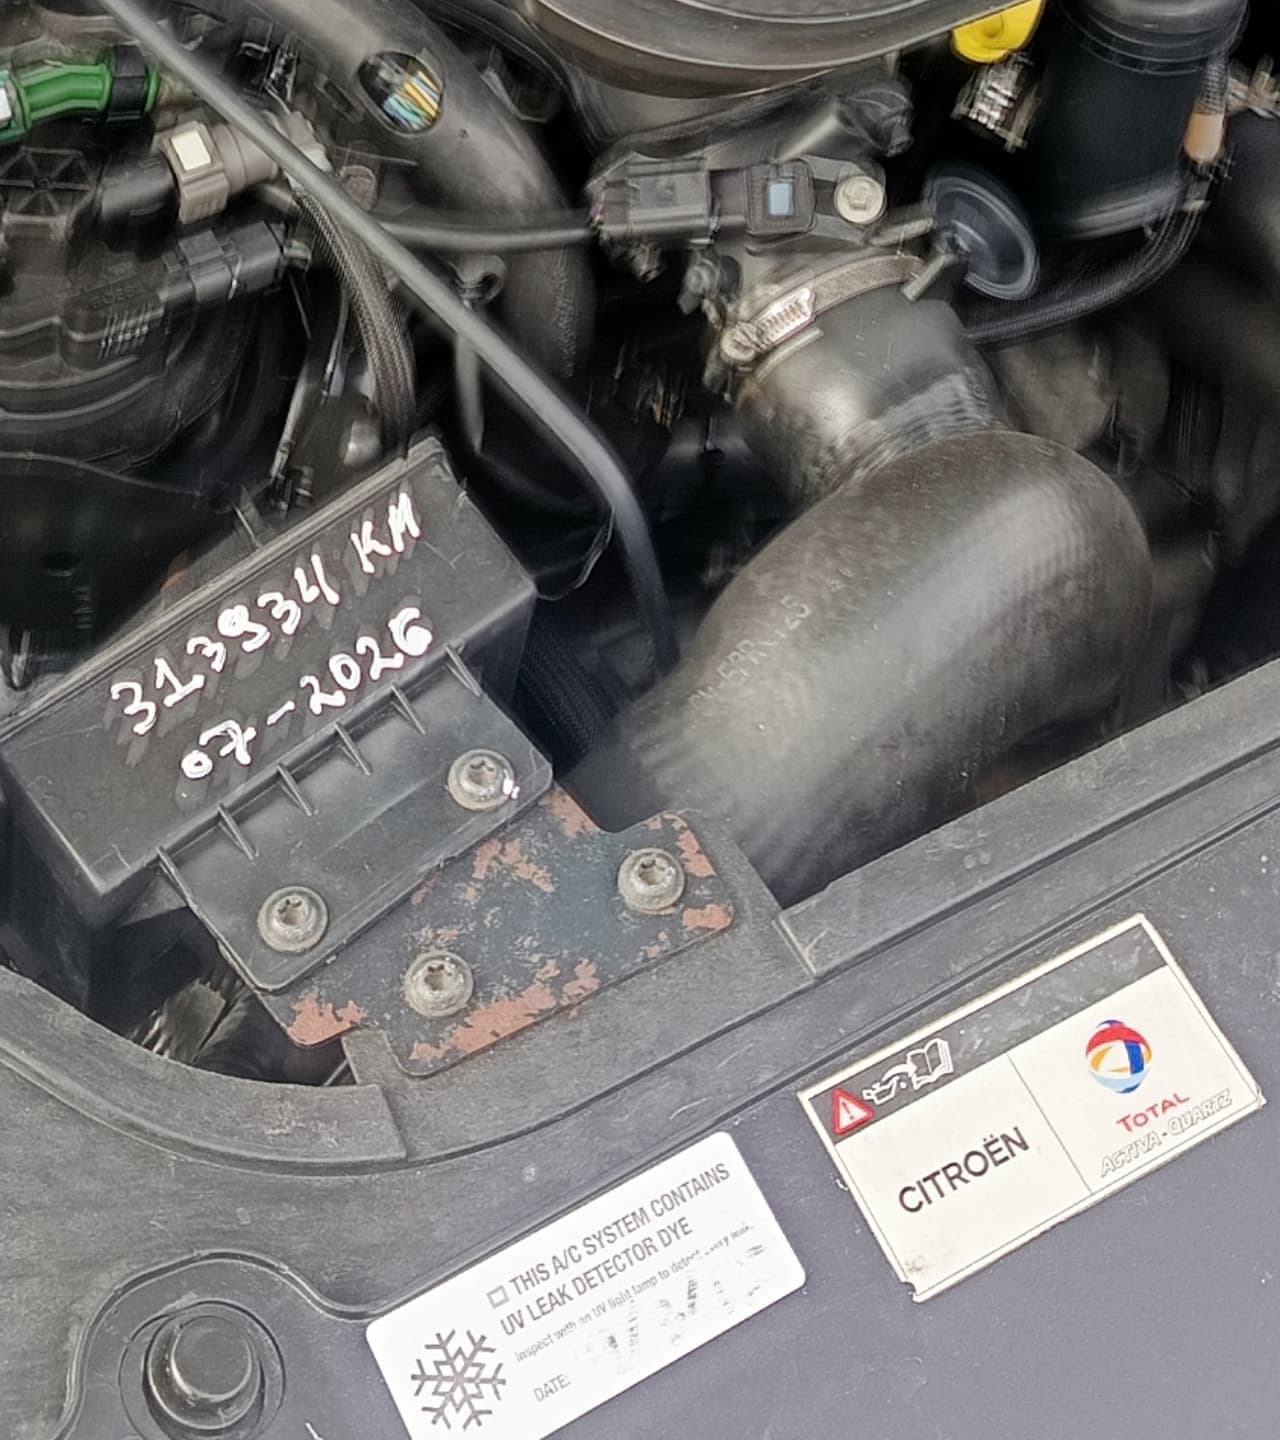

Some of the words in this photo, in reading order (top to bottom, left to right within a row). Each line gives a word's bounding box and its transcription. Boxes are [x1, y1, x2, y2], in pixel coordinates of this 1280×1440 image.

[180, 607, 433, 779] 07-2026
[1115, 1091, 1191, 1134] TOTAL
[897, 1125, 1030, 1214] CITROËN
[500, 1312, 524, 1337] UV
[525, 1286, 574, 1321] LEAK
[571, 1236, 659, 1296] DETECTOR
[657, 1216, 693, 1249] DYE
[508, 1262, 551, 1296] THIS
[552, 1245, 583, 1276] A/C
[582, 1207, 651, 1256] SYSTEM
[650, 1162, 731, 1218] CONTAINS
[532, 1372, 572, 1403] DATE:
